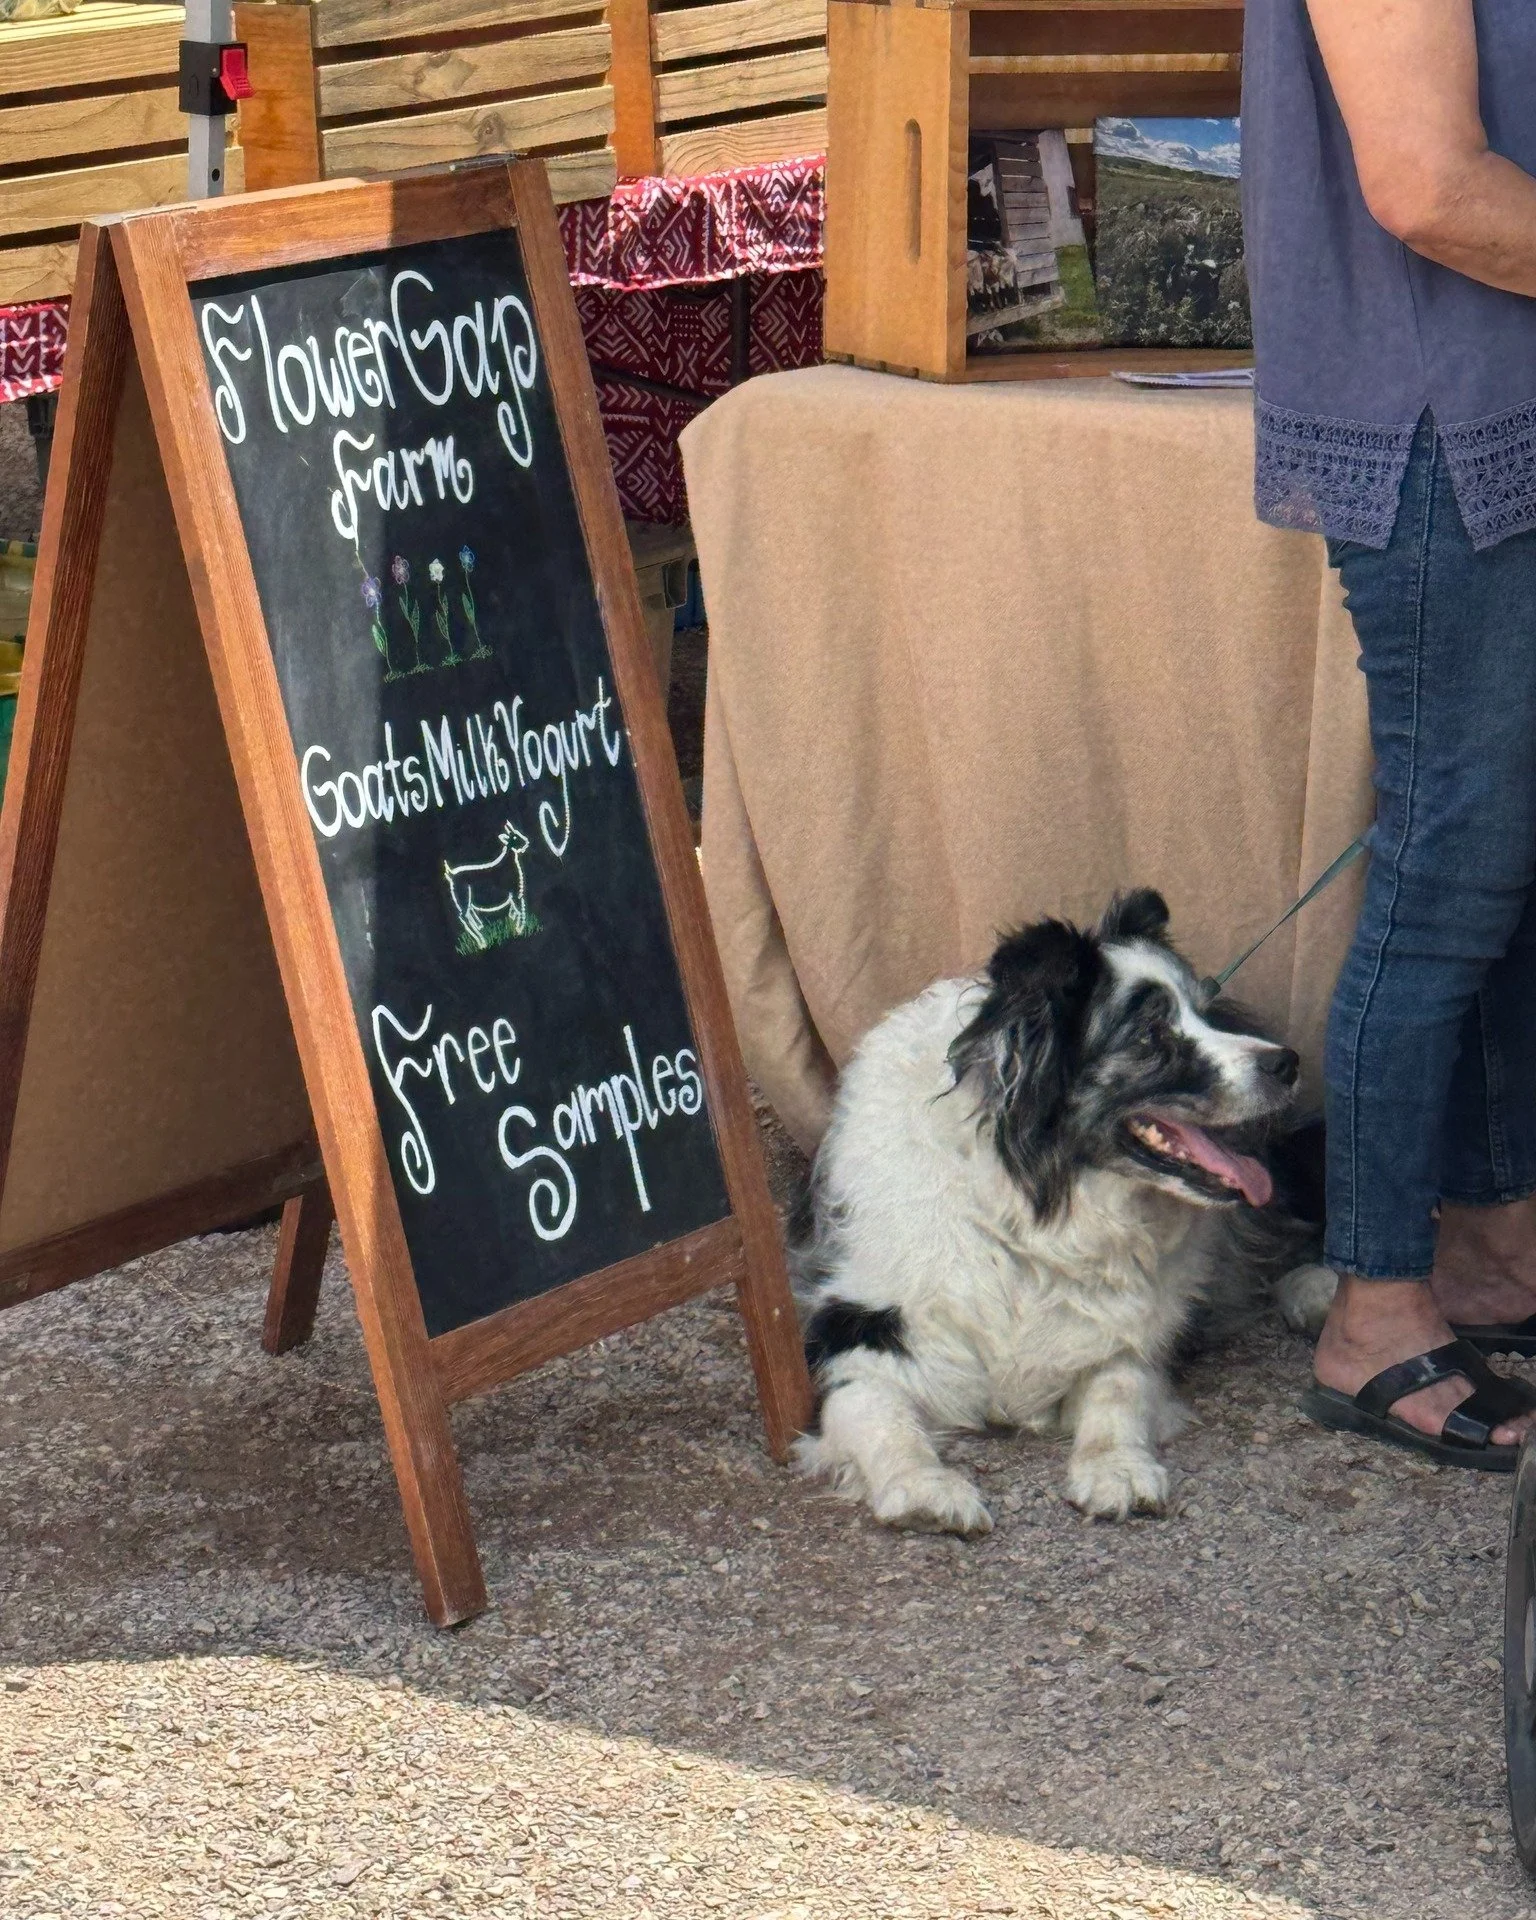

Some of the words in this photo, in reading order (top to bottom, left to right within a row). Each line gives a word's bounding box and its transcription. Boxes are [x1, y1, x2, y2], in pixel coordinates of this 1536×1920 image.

[202, 294, 397, 445] Flower
[390, 270, 537, 468] Gap
[331, 430, 473, 546] Farm
[302, 721, 427, 837] Goats
[421, 713, 510, 807] Milk
[494, 677, 621, 857] Yogurt
[372, 1003, 522, 1195] Free
[498, 1025, 702, 1242] Samples
